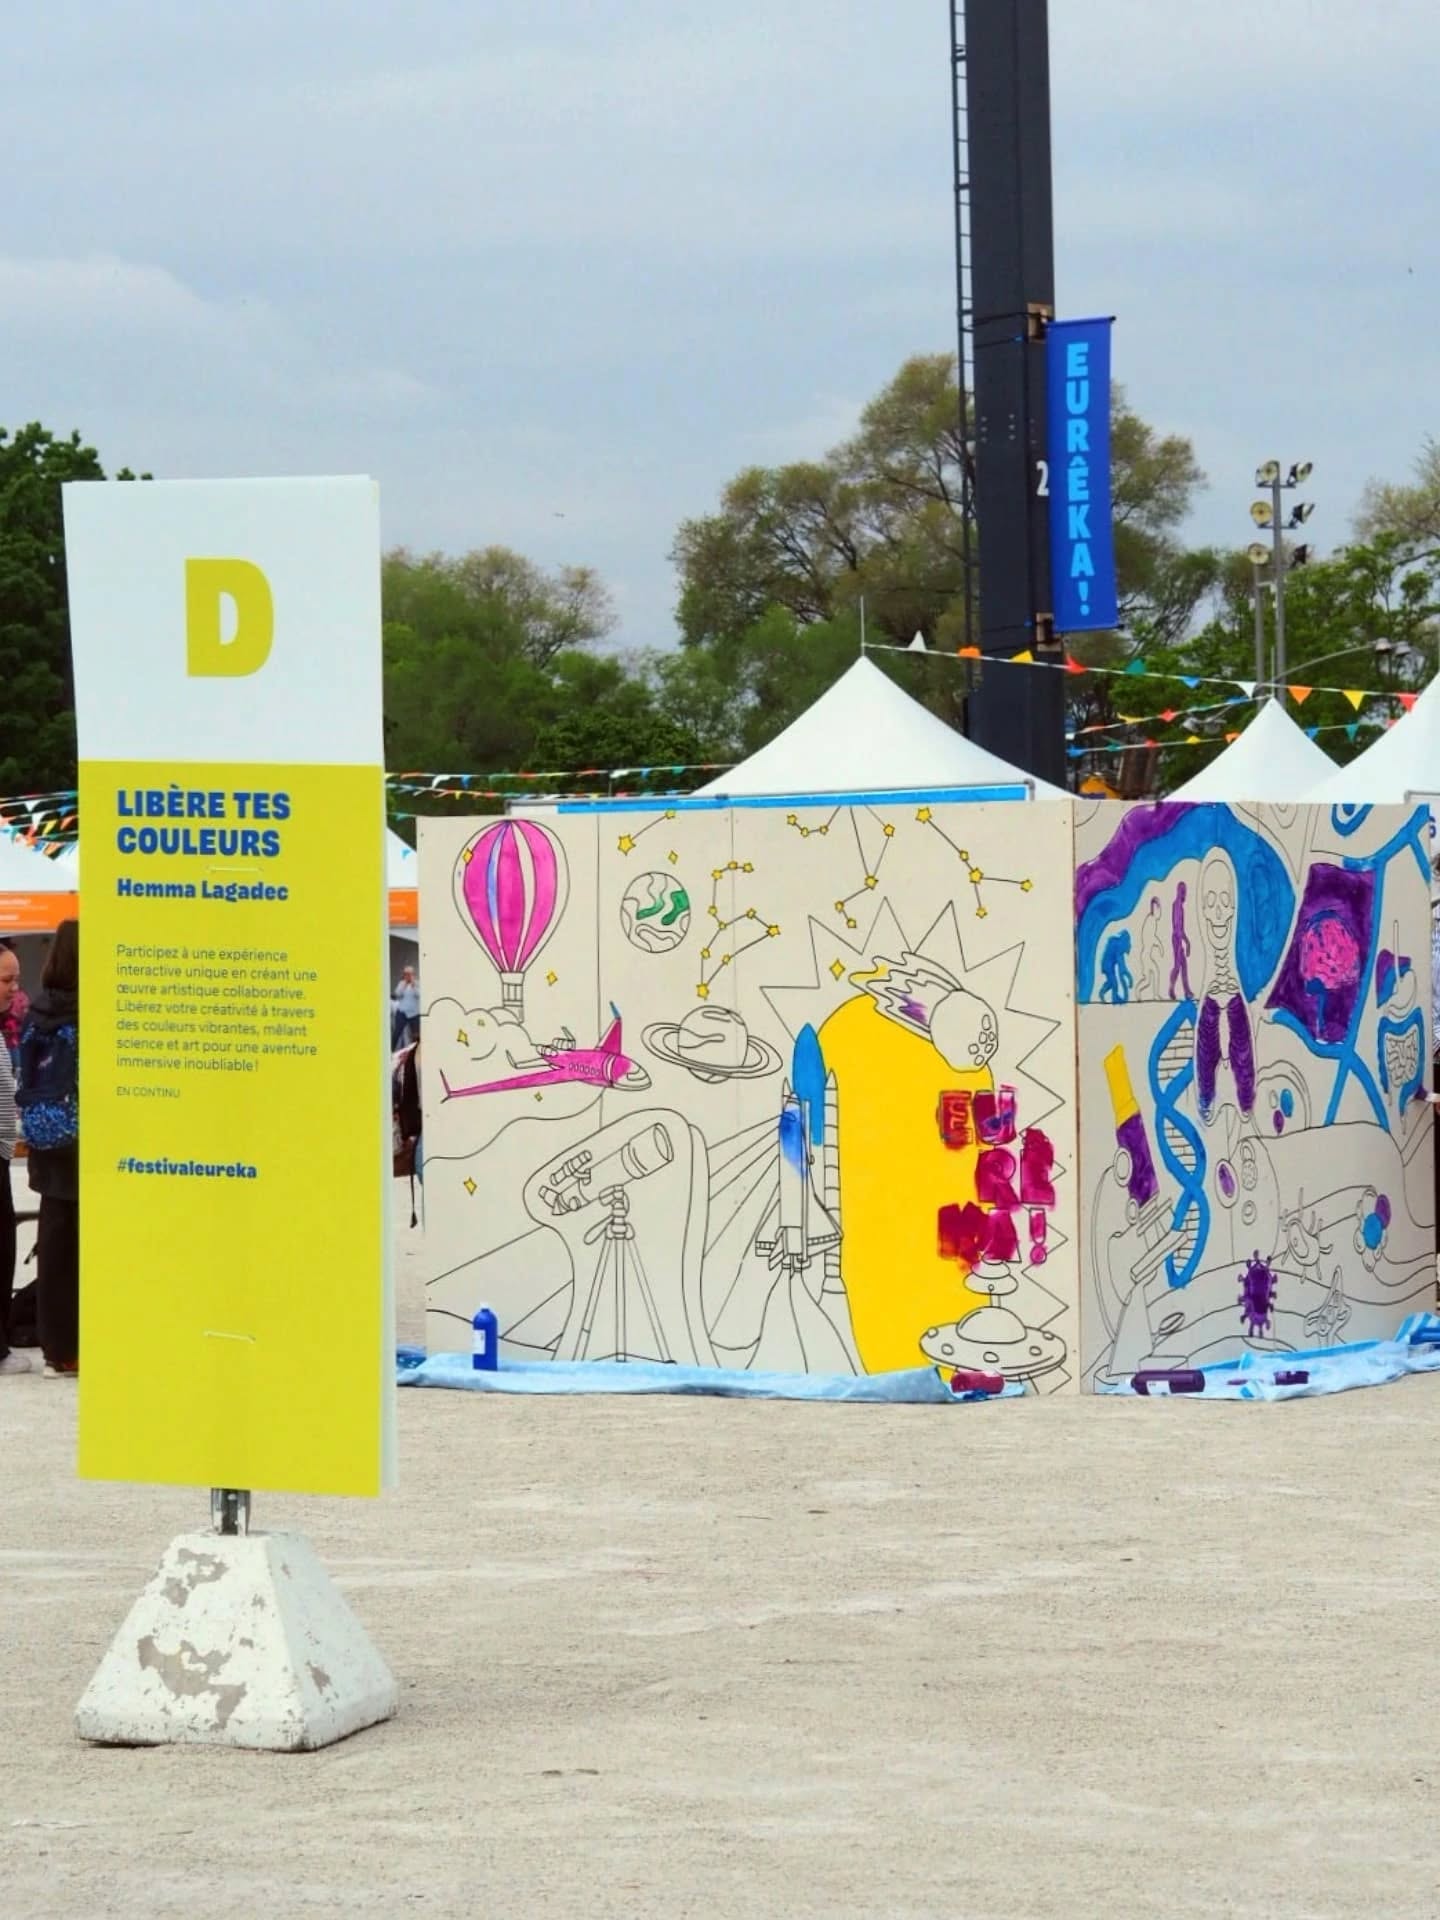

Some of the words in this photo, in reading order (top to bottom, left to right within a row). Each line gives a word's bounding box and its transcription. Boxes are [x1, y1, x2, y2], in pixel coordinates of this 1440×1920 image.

[1036, 460, 1049, 497] 2
[1066, 343, 1095, 616] EURÊKA!
[185, 558, 275, 678] D
[117, 784, 225, 819] LIBÈRE
[233, 792, 291, 819] TES
[117, 827, 281, 857] COULEURS
[117, 878, 196, 898] Hemma
[202, 880, 289, 902] Lagadec
[117, 944, 179, 960] Participez
[182, 946, 189, 959] à
[193, 950, 216, 960] une
[219, 948, 289, 962] expérience
[117, 963, 182, 976] interactive
[186, 967, 229, 979] unique
[232, 969, 247, 978] en
[251, 968, 290, 980] créant
[294, 971, 317, 981] une
[117, 984, 157, 994] œuvre
[160, 984, 221, 997] artistique
[117, 1000, 163, 1013] Libérez
[166, 1003, 197, 1014] votre
[200, 1004, 259, 1016] créativité
[262, 1005, 269, 1016] à
[272, 1006, 316, 1019] travers
[117, 1018, 139, 1031] des
[143, 1020, 197, 1032] couleurs
[199, 1022, 260, 1035] vibrantes,
[264, 1024, 307, 1037] mêlant
[117, 1039, 164, 1050] science
[167, 1040, 179, 1050] et
[182, 1041, 200, 1051] art
[202, 1042, 232, 1053] pour
[236, 1044, 259, 1053] une
[262, 1043, 318, 1056] aventure
[117, 1054, 181, 1069] immersive
[117, 1086, 131, 1096] EN
[134, 1087, 181, 1098] CONTINU
[118, 1157, 258, 1179] #festivaleureka
